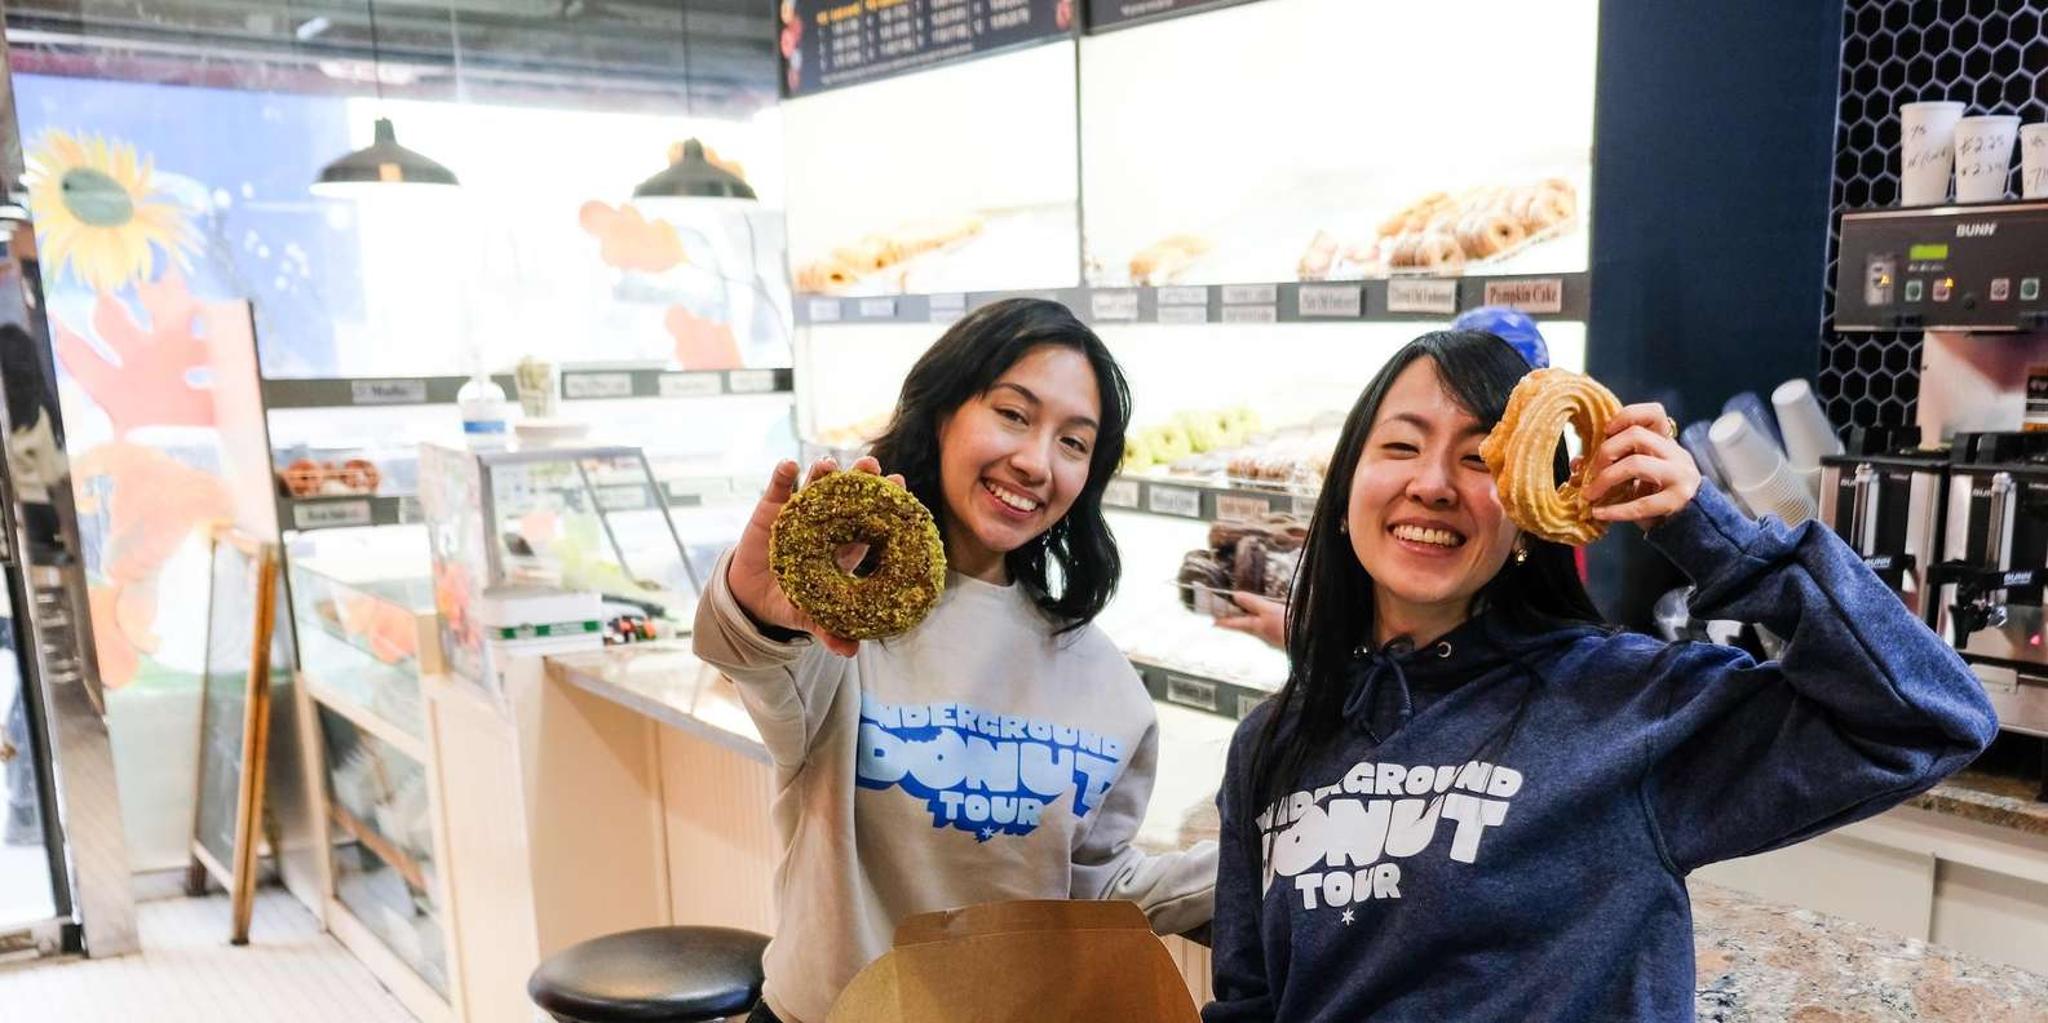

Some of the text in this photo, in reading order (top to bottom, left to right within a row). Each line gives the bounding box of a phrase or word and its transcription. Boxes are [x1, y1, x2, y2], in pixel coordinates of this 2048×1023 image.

[1956, 223, 1997, 237] BUNN
[1490, 284, 1557, 304] Pumpkin Cake
[858, 722, 1120, 808] DONUT
[938, 791, 1046, 827] TOUR
[1295, 862, 1402, 910] TOUR
